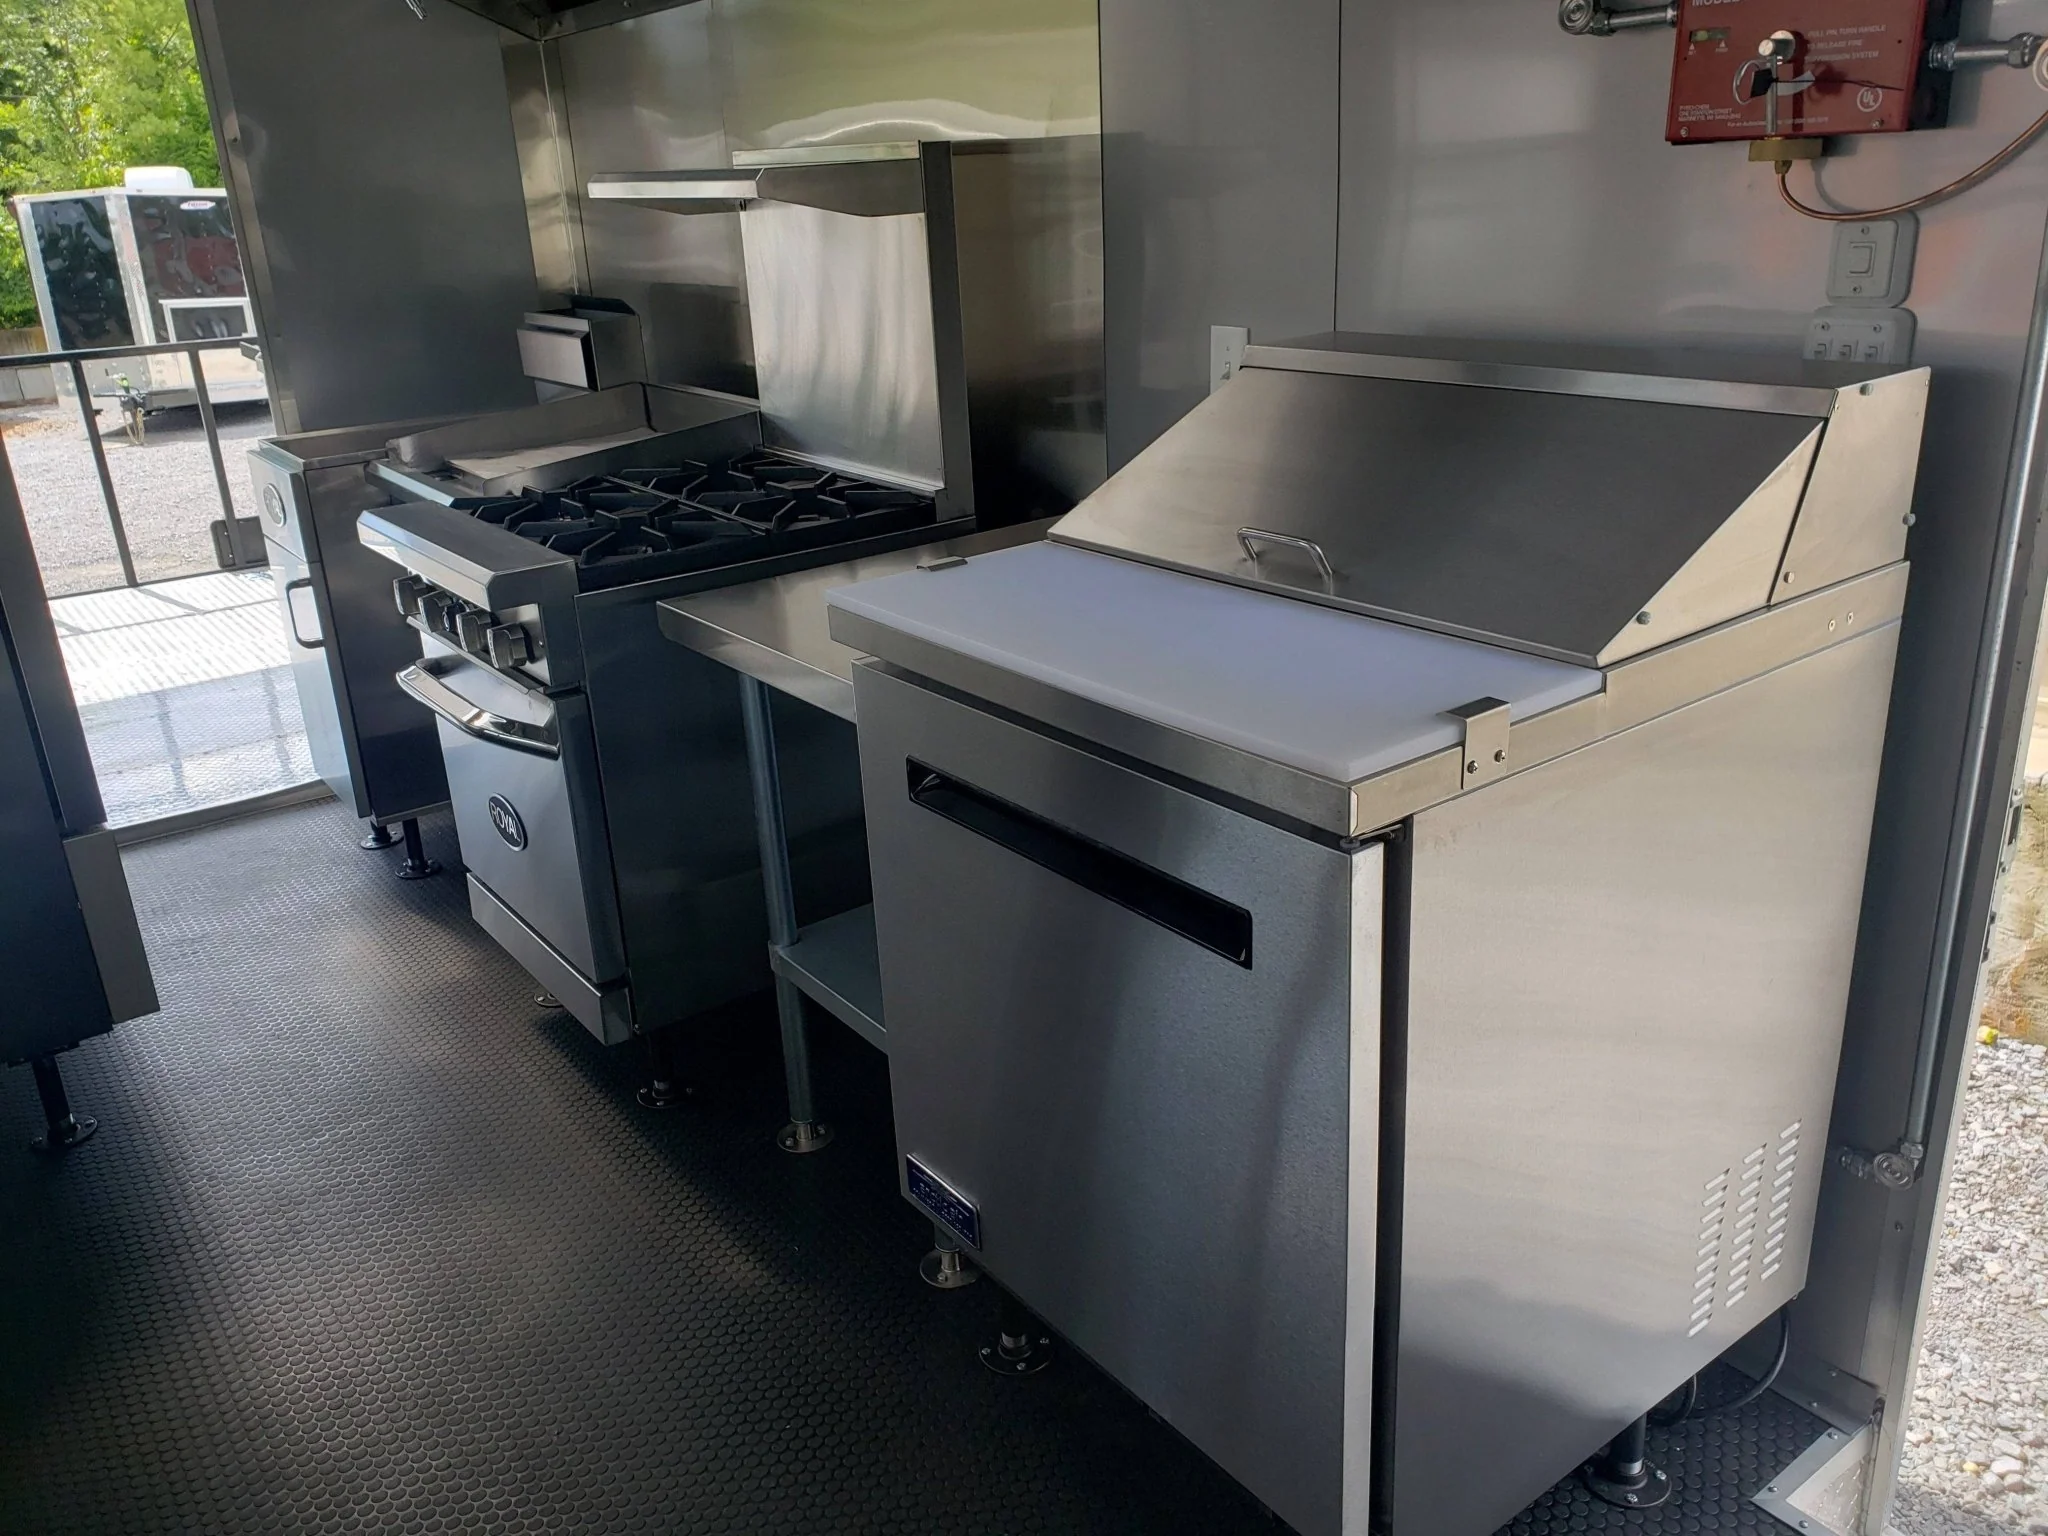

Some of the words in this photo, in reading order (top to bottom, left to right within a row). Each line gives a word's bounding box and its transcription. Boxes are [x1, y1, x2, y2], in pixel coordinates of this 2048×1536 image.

[1858, 24, 1887, 33] HANDLE
[1852, 50, 1879, 59] SYSTEM
[490, 801, 521, 842] ROYAL
